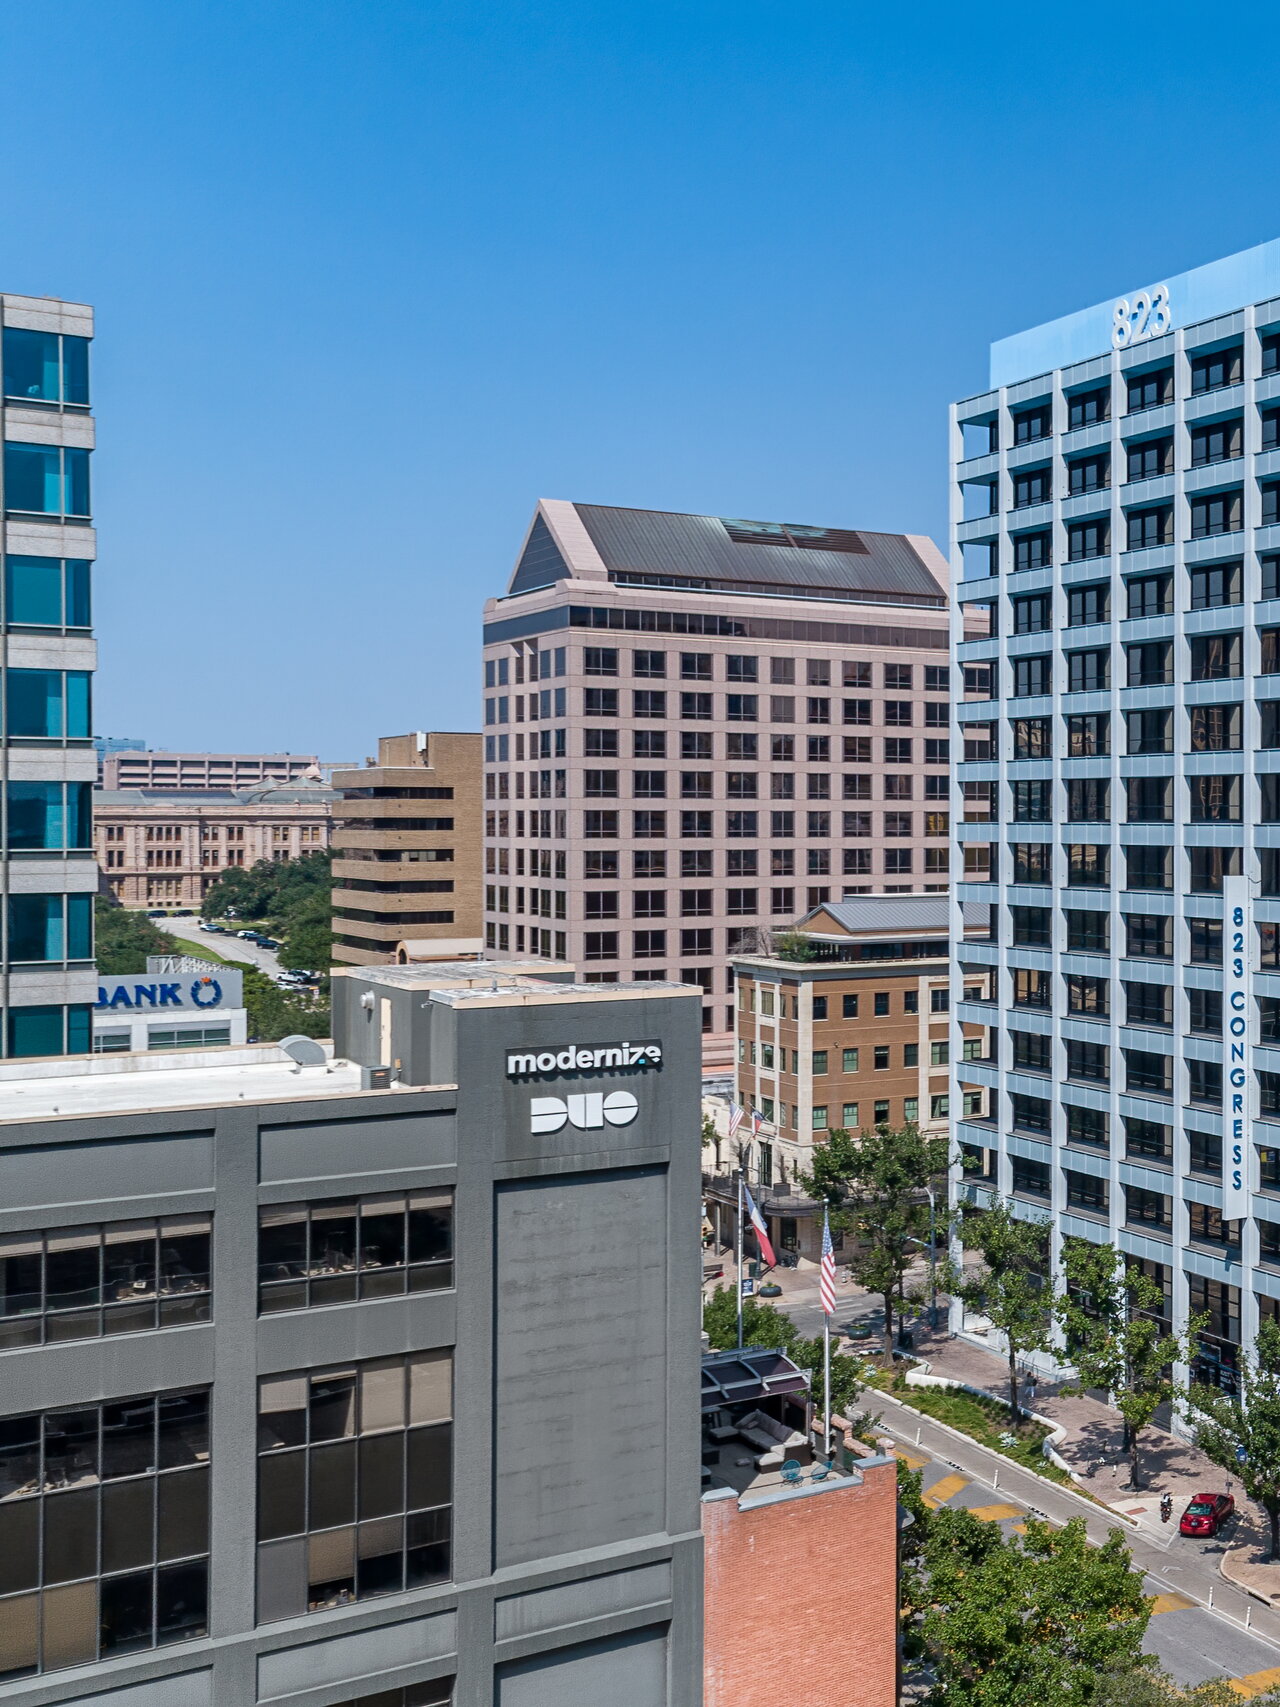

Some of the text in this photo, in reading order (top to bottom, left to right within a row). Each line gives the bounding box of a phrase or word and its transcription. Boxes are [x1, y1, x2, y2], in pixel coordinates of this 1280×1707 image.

[1111, 284, 1171, 350] 823
[507, 1042, 662, 1075] modernize
[1229, 906, 1246, 1191] 823 CONGRESS
[530, 1090, 639, 1134] DUO
